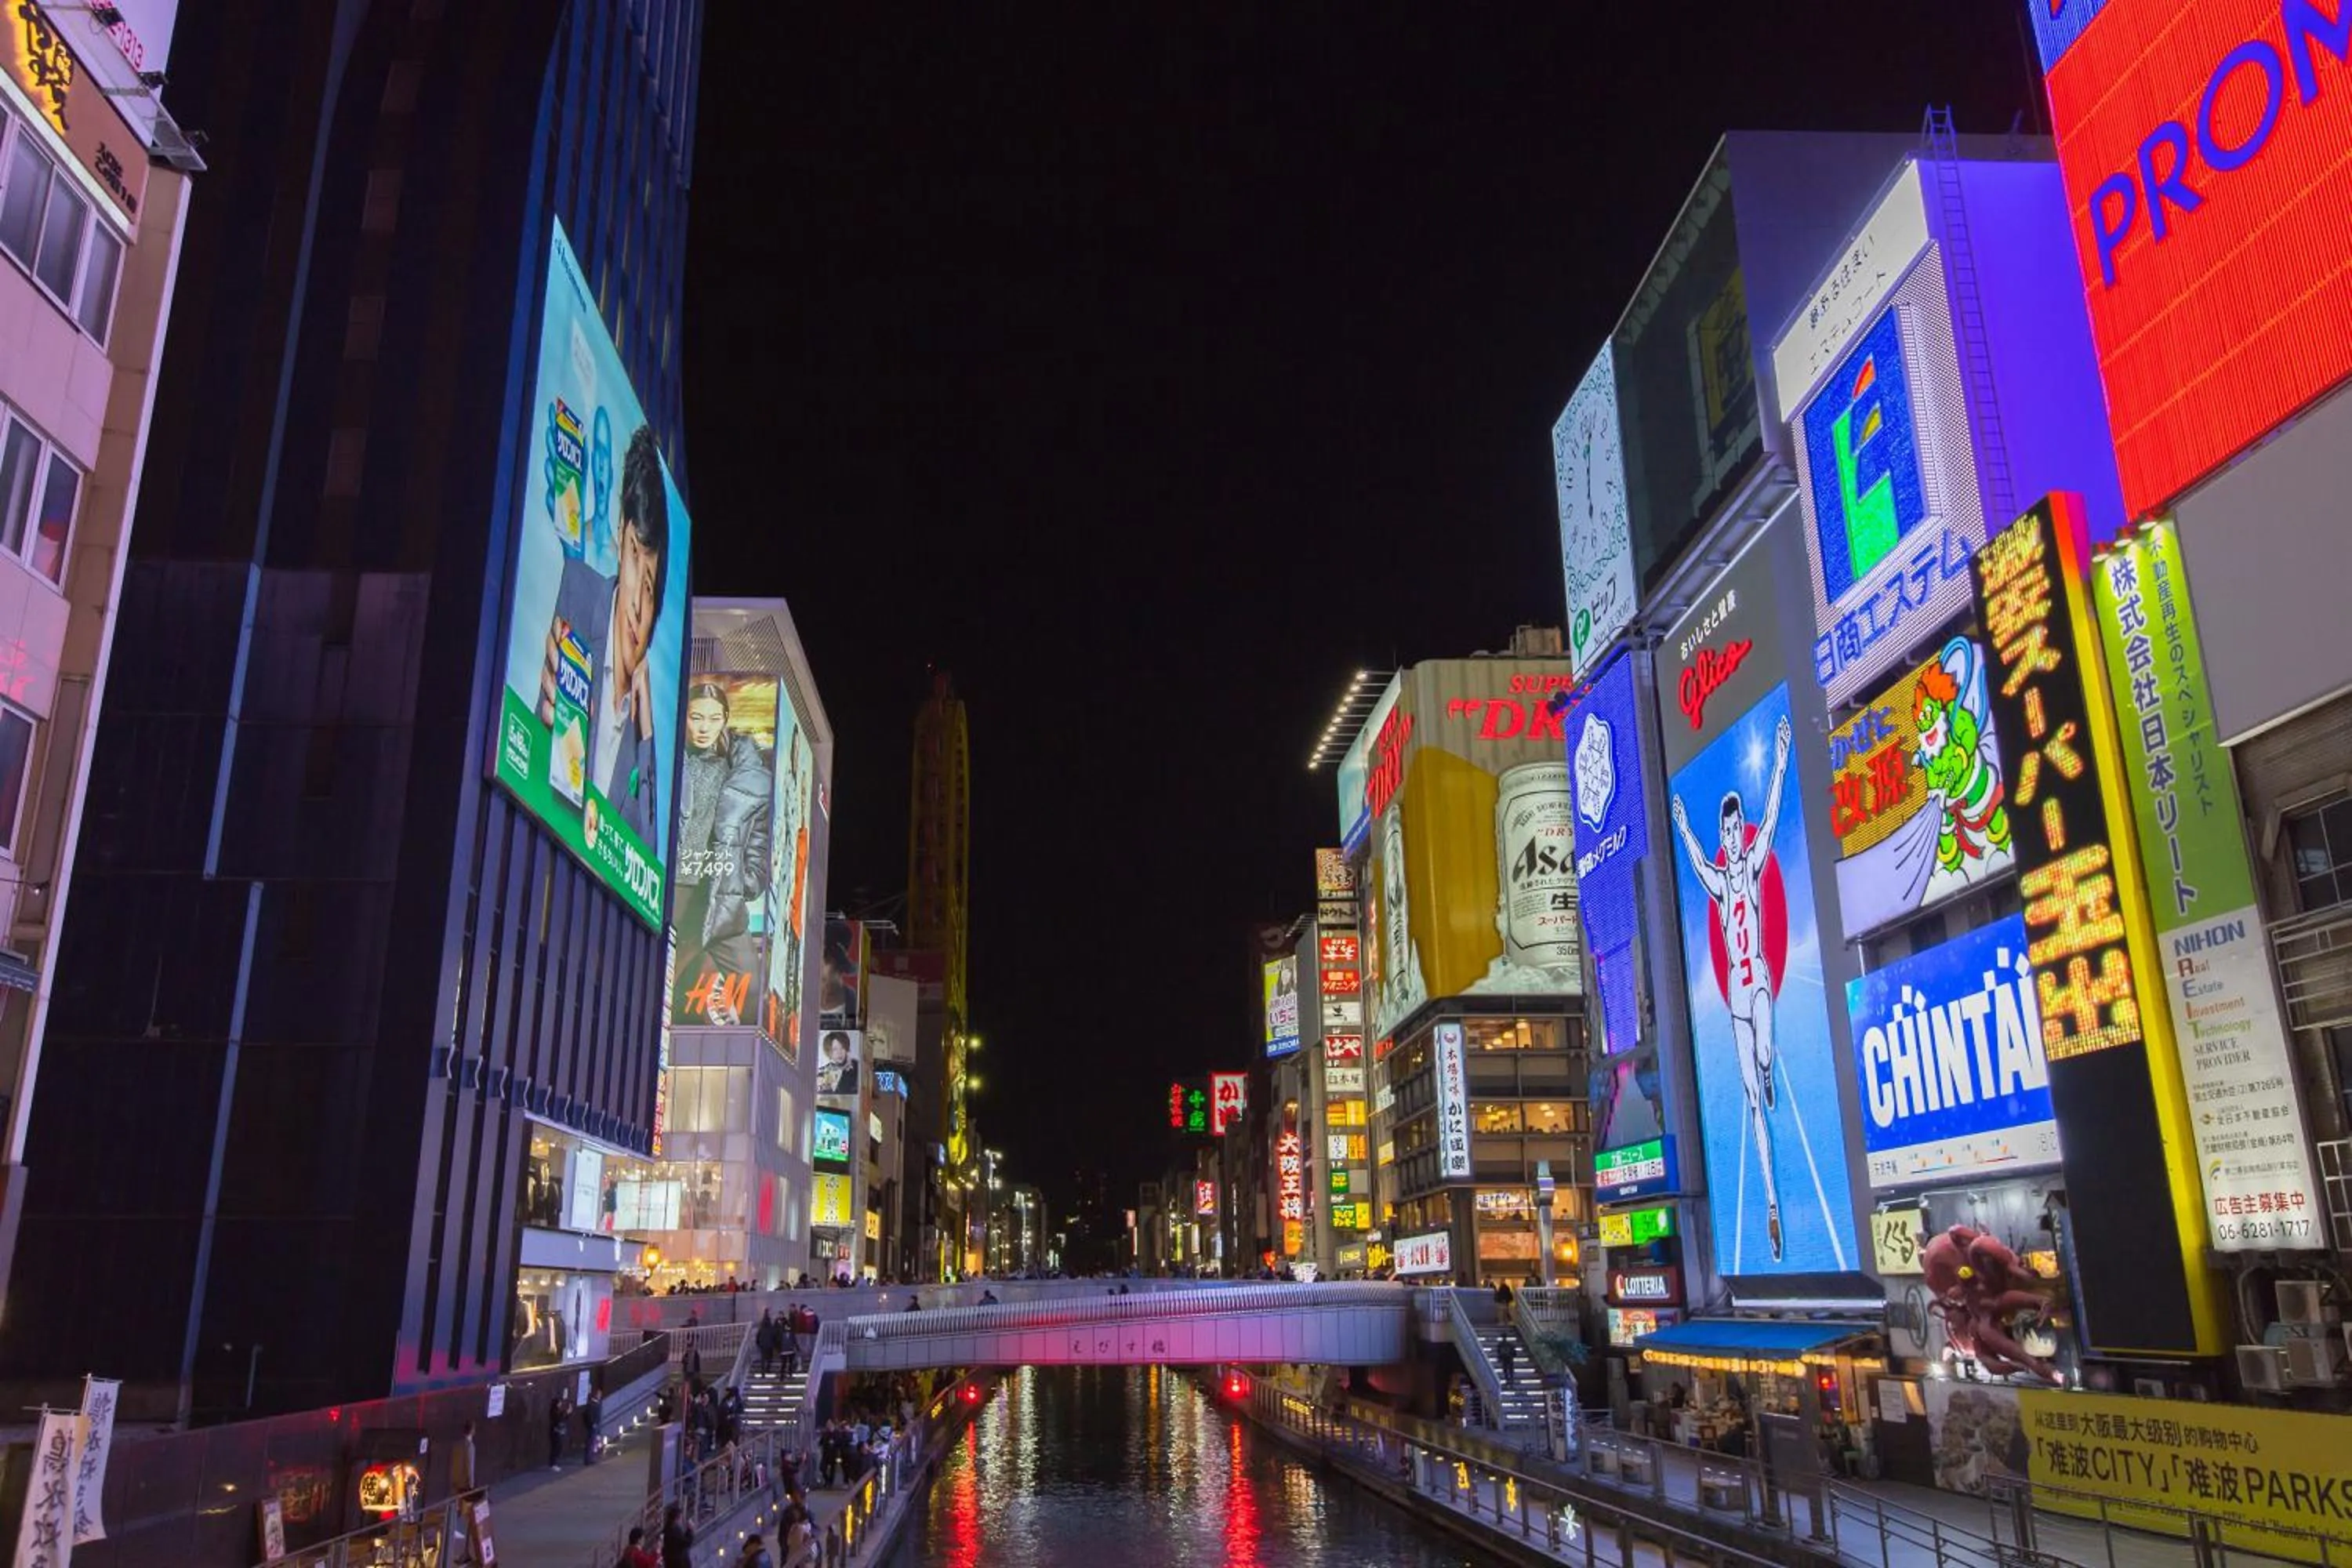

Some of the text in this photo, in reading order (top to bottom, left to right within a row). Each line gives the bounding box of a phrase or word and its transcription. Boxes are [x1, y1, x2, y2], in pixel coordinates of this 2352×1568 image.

[1592, 572, 1617, 625] ピップ
[1812, 528, 1970, 688] 日商エステム
[2149, 539, 2213, 817] 不動産再生のスペシャリスト
[2111, 558, 2198, 919] 株式会社日本リート
[1828, 737, 1908, 840] 改源
[1977, 514, 2142, 1060] 激安スーパー玉出
[681, 849, 733, 860] ジャケット
[681, 862, 735, 877] ¥7,499
[1732, 893, 1754, 987] グリコ
[2174, 920, 2246, 957] NIHON
[2178, 957, 2211, 978] Real
[2183, 978, 2225, 999] Estate
[2185, 996, 2245, 1020] Investment
[2187, 1019, 2252, 1040] Technology
[1862, 975, 2049, 1128] CHINTAI
[2194, 1036, 2239, 1057] SERVICE
[2195, 1050, 2252, 1072] PROVIDER
[2214, 1189, 2306, 1216] 広告主募集中
[2219, 1220, 2310, 1240] 06-6281-1717
[1624, 1276, 1667, 1295] LOTTERIA
